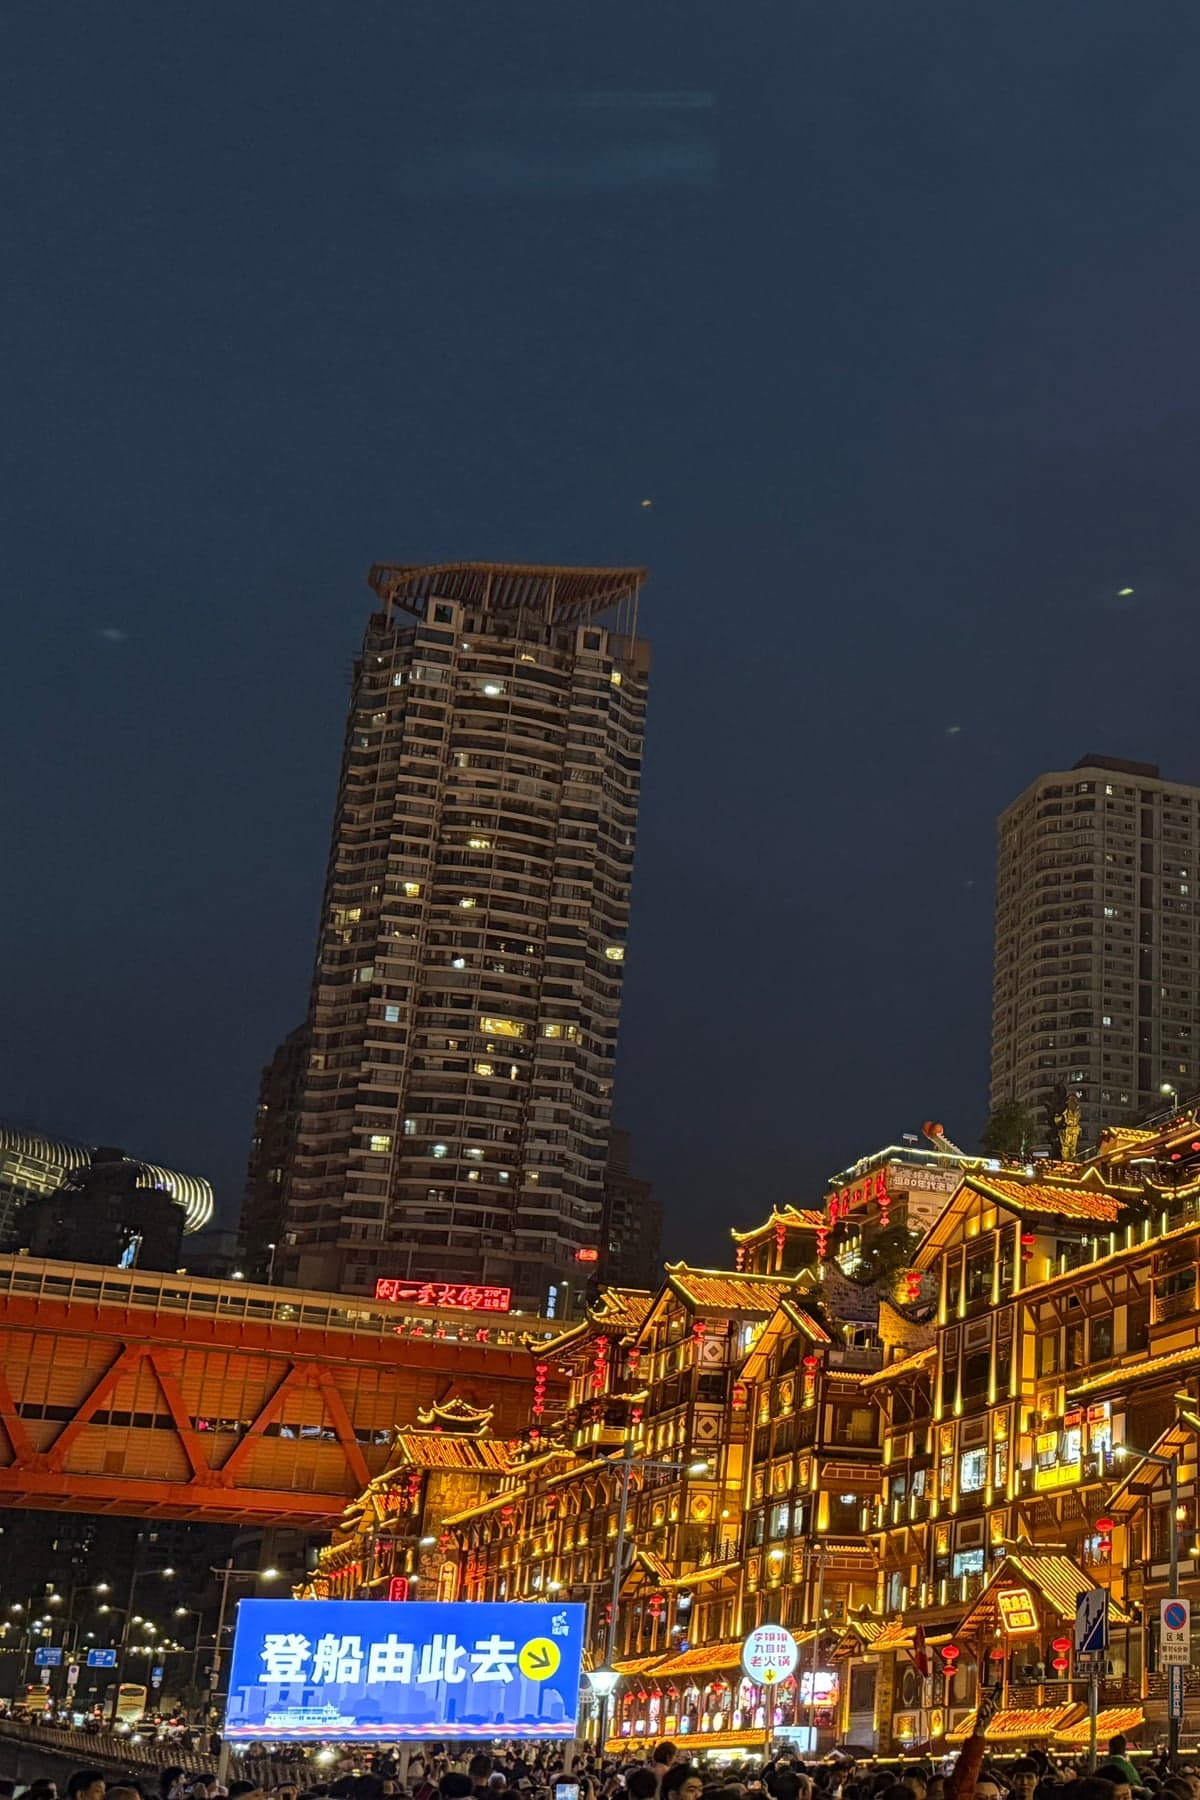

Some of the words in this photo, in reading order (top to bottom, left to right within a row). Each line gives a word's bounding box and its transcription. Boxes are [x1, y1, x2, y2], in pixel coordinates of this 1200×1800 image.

[259, 1633, 517, 1685] 登船由此去
[750, 1656, 790, 1668] 老火锅
